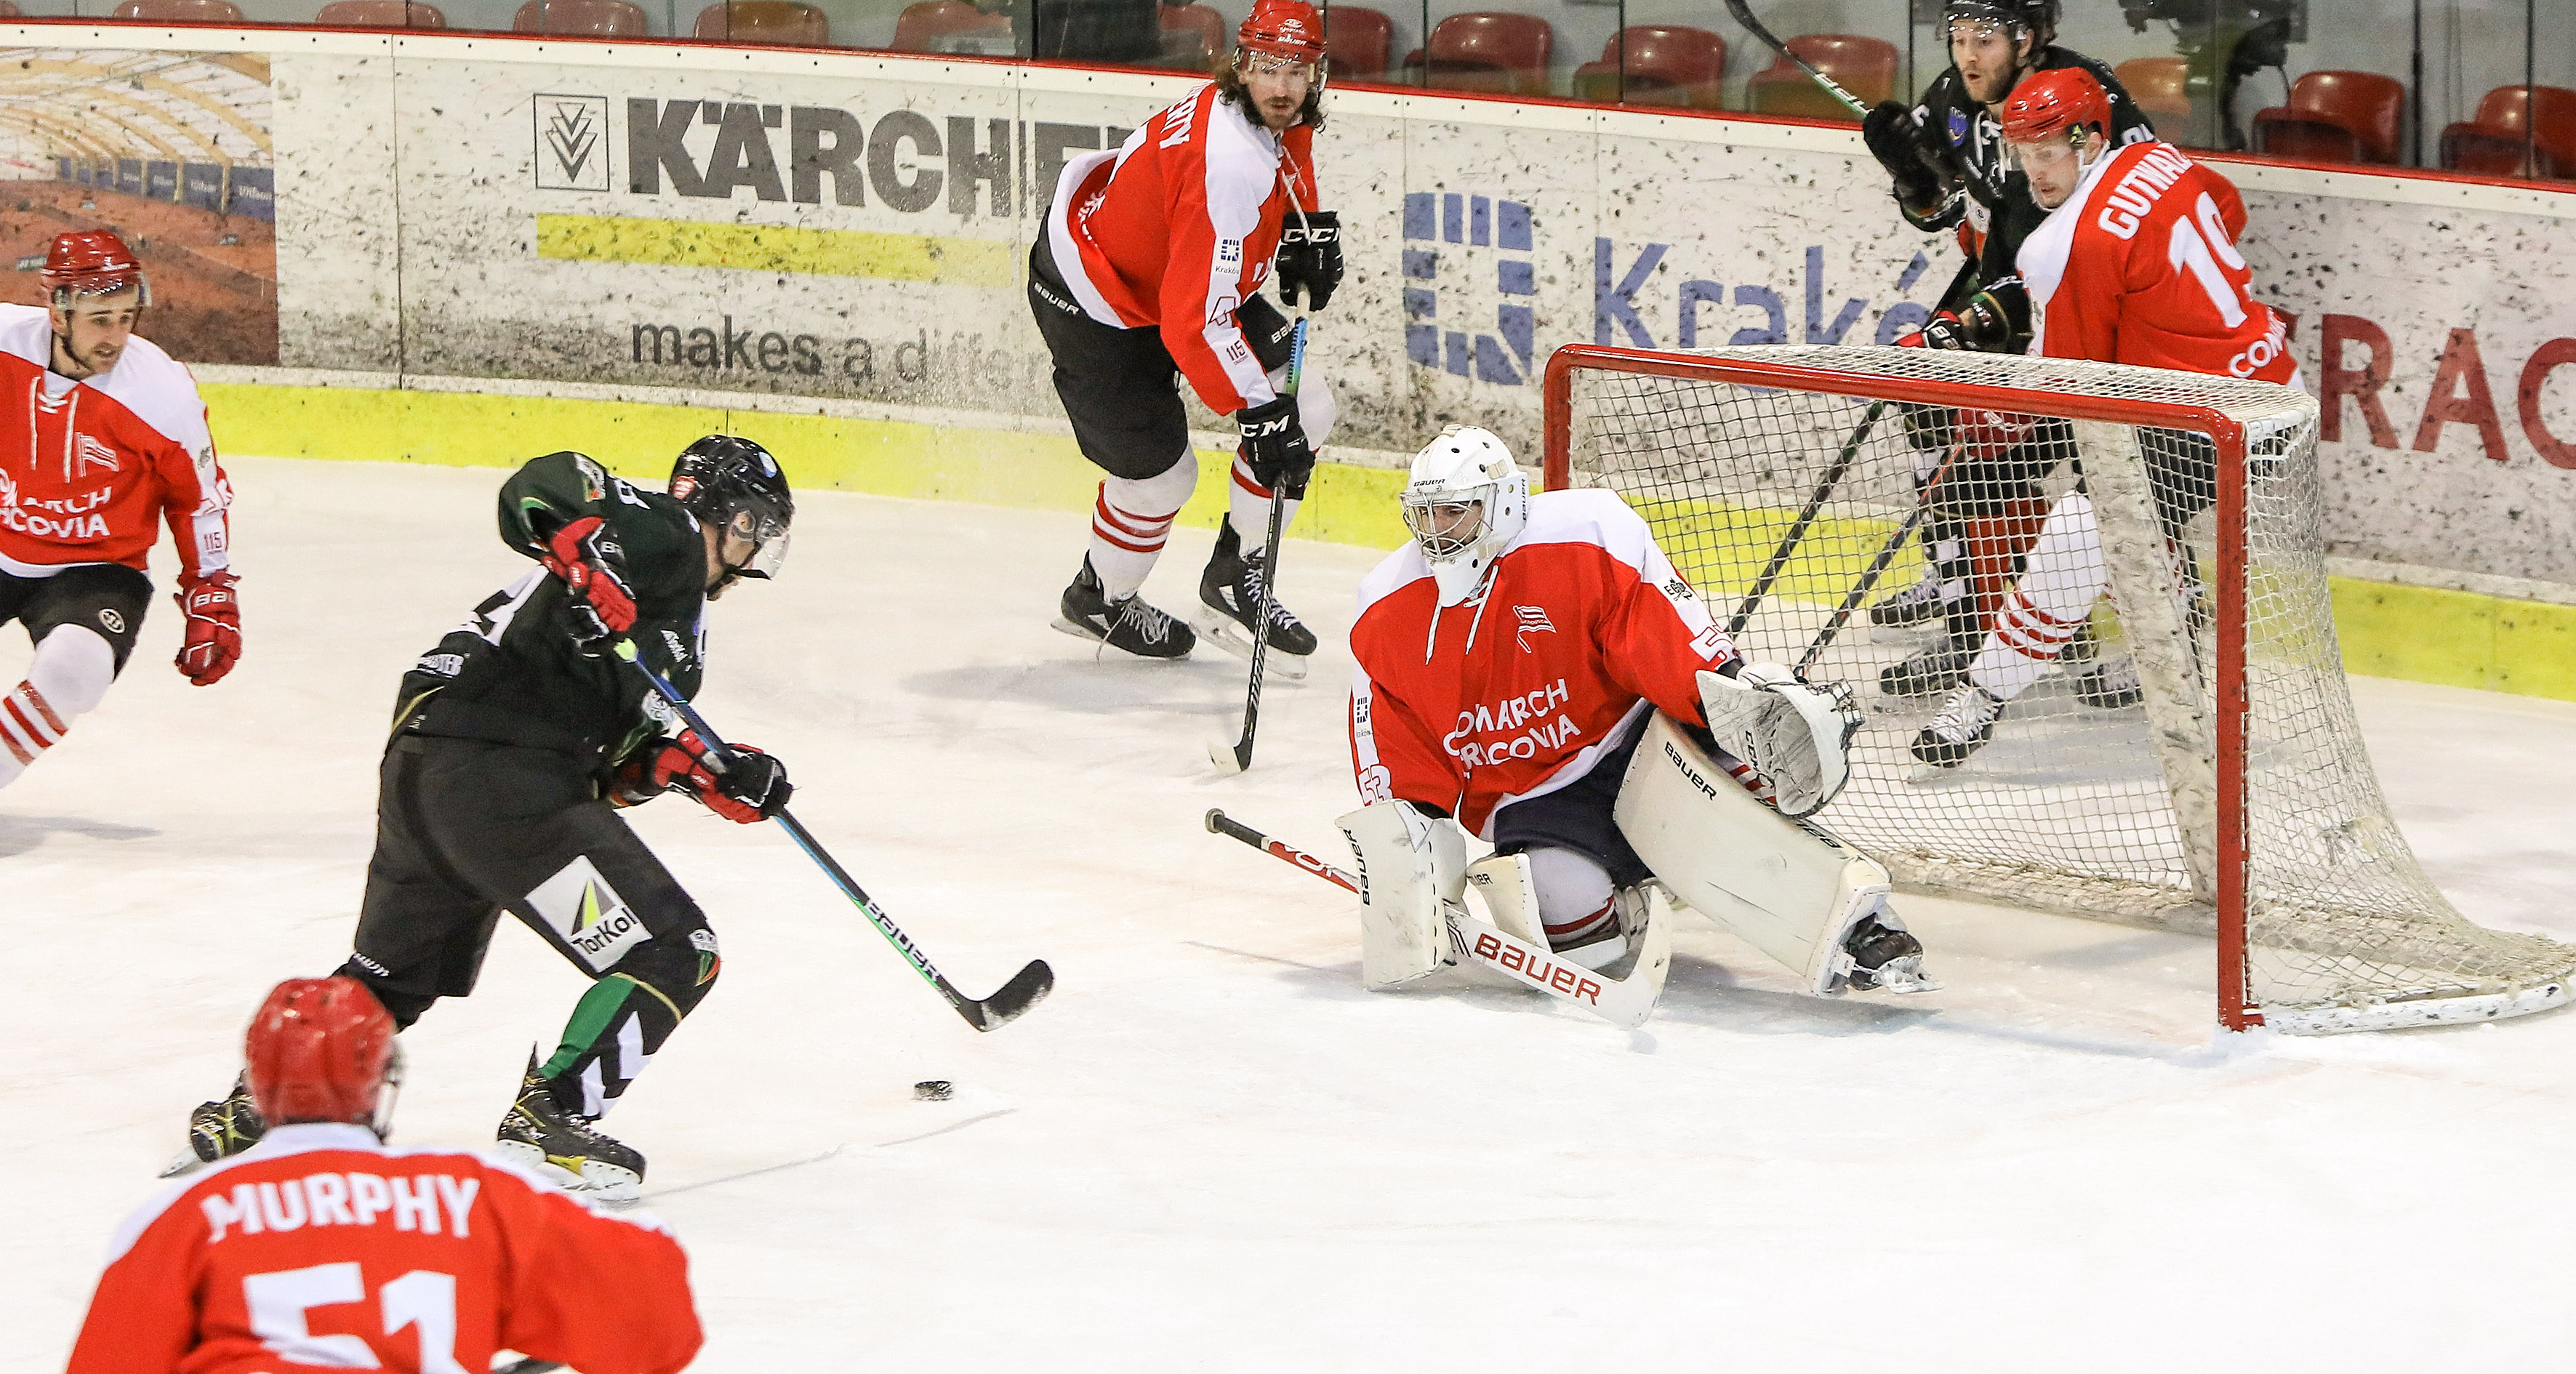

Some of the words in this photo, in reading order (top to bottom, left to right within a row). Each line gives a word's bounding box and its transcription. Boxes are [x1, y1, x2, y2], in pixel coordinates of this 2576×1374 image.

[627, 97, 1136, 220] KÄRCHE
[633, 313, 823, 376] makes
[843, 337, 877, 383] a
[1357, 764, 1394, 806] 53
[571, 907, 639, 955] TorKol
[199, 1171, 481, 1244] MURPHY
[242, 1261, 473, 1374] 51
